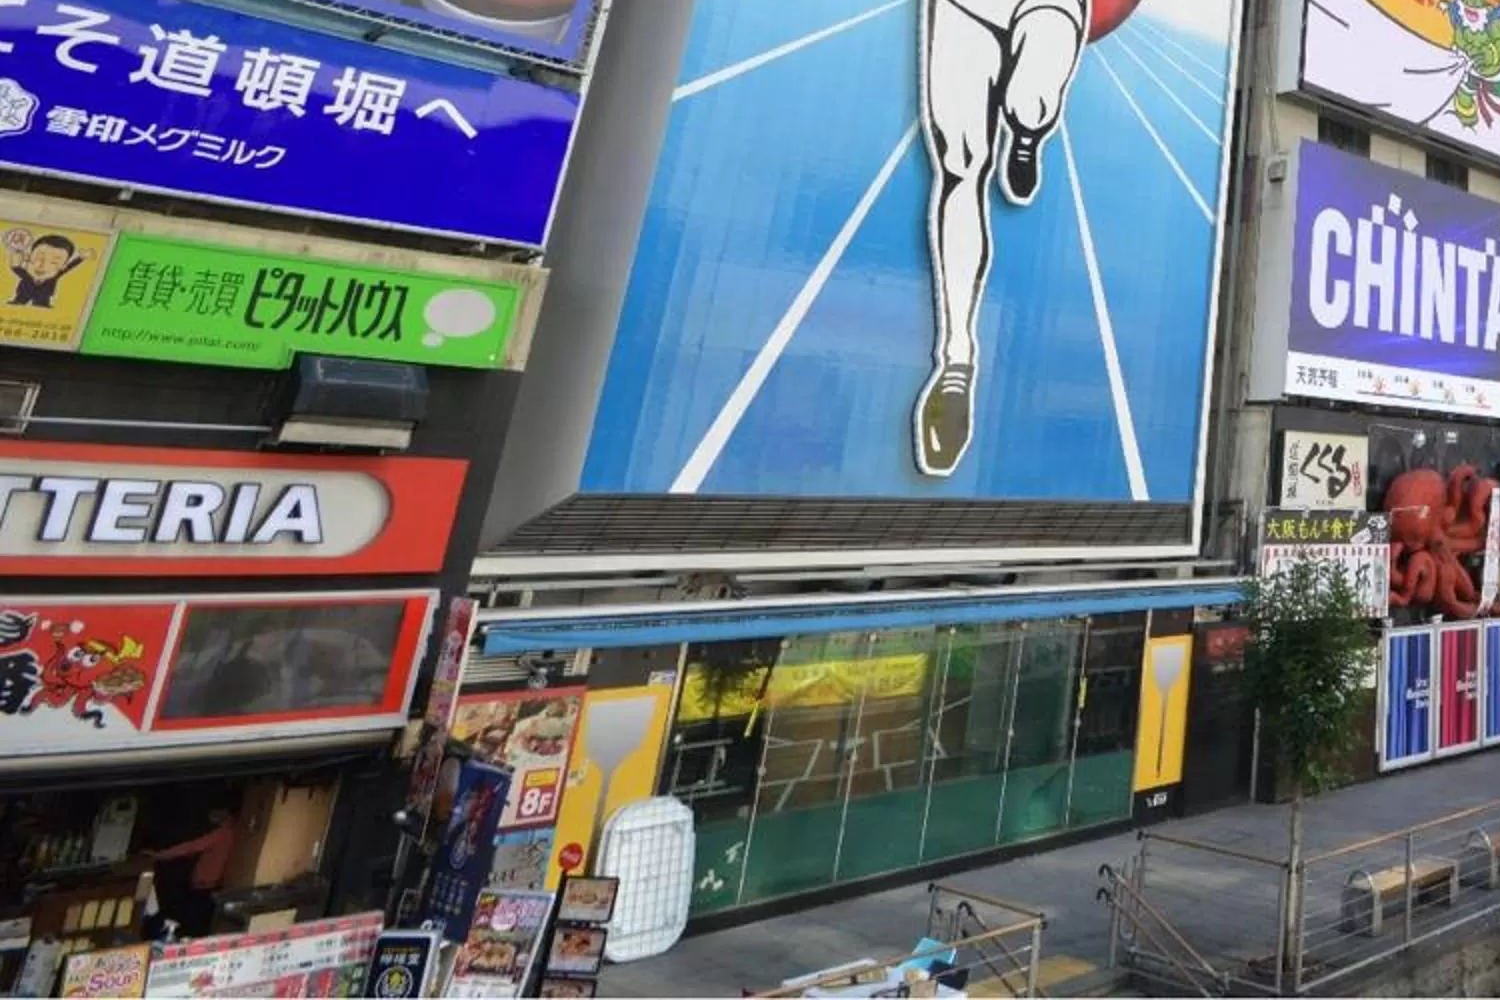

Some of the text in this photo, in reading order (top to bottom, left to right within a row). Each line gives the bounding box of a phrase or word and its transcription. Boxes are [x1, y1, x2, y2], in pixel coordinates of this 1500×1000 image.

[45, 104, 287, 169] 雪印メグミルク
[243, 267, 410, 343] ピタットハウス
[1300, 442, 1352, 499] くくる
[520, 787, 553, 816] 8F
